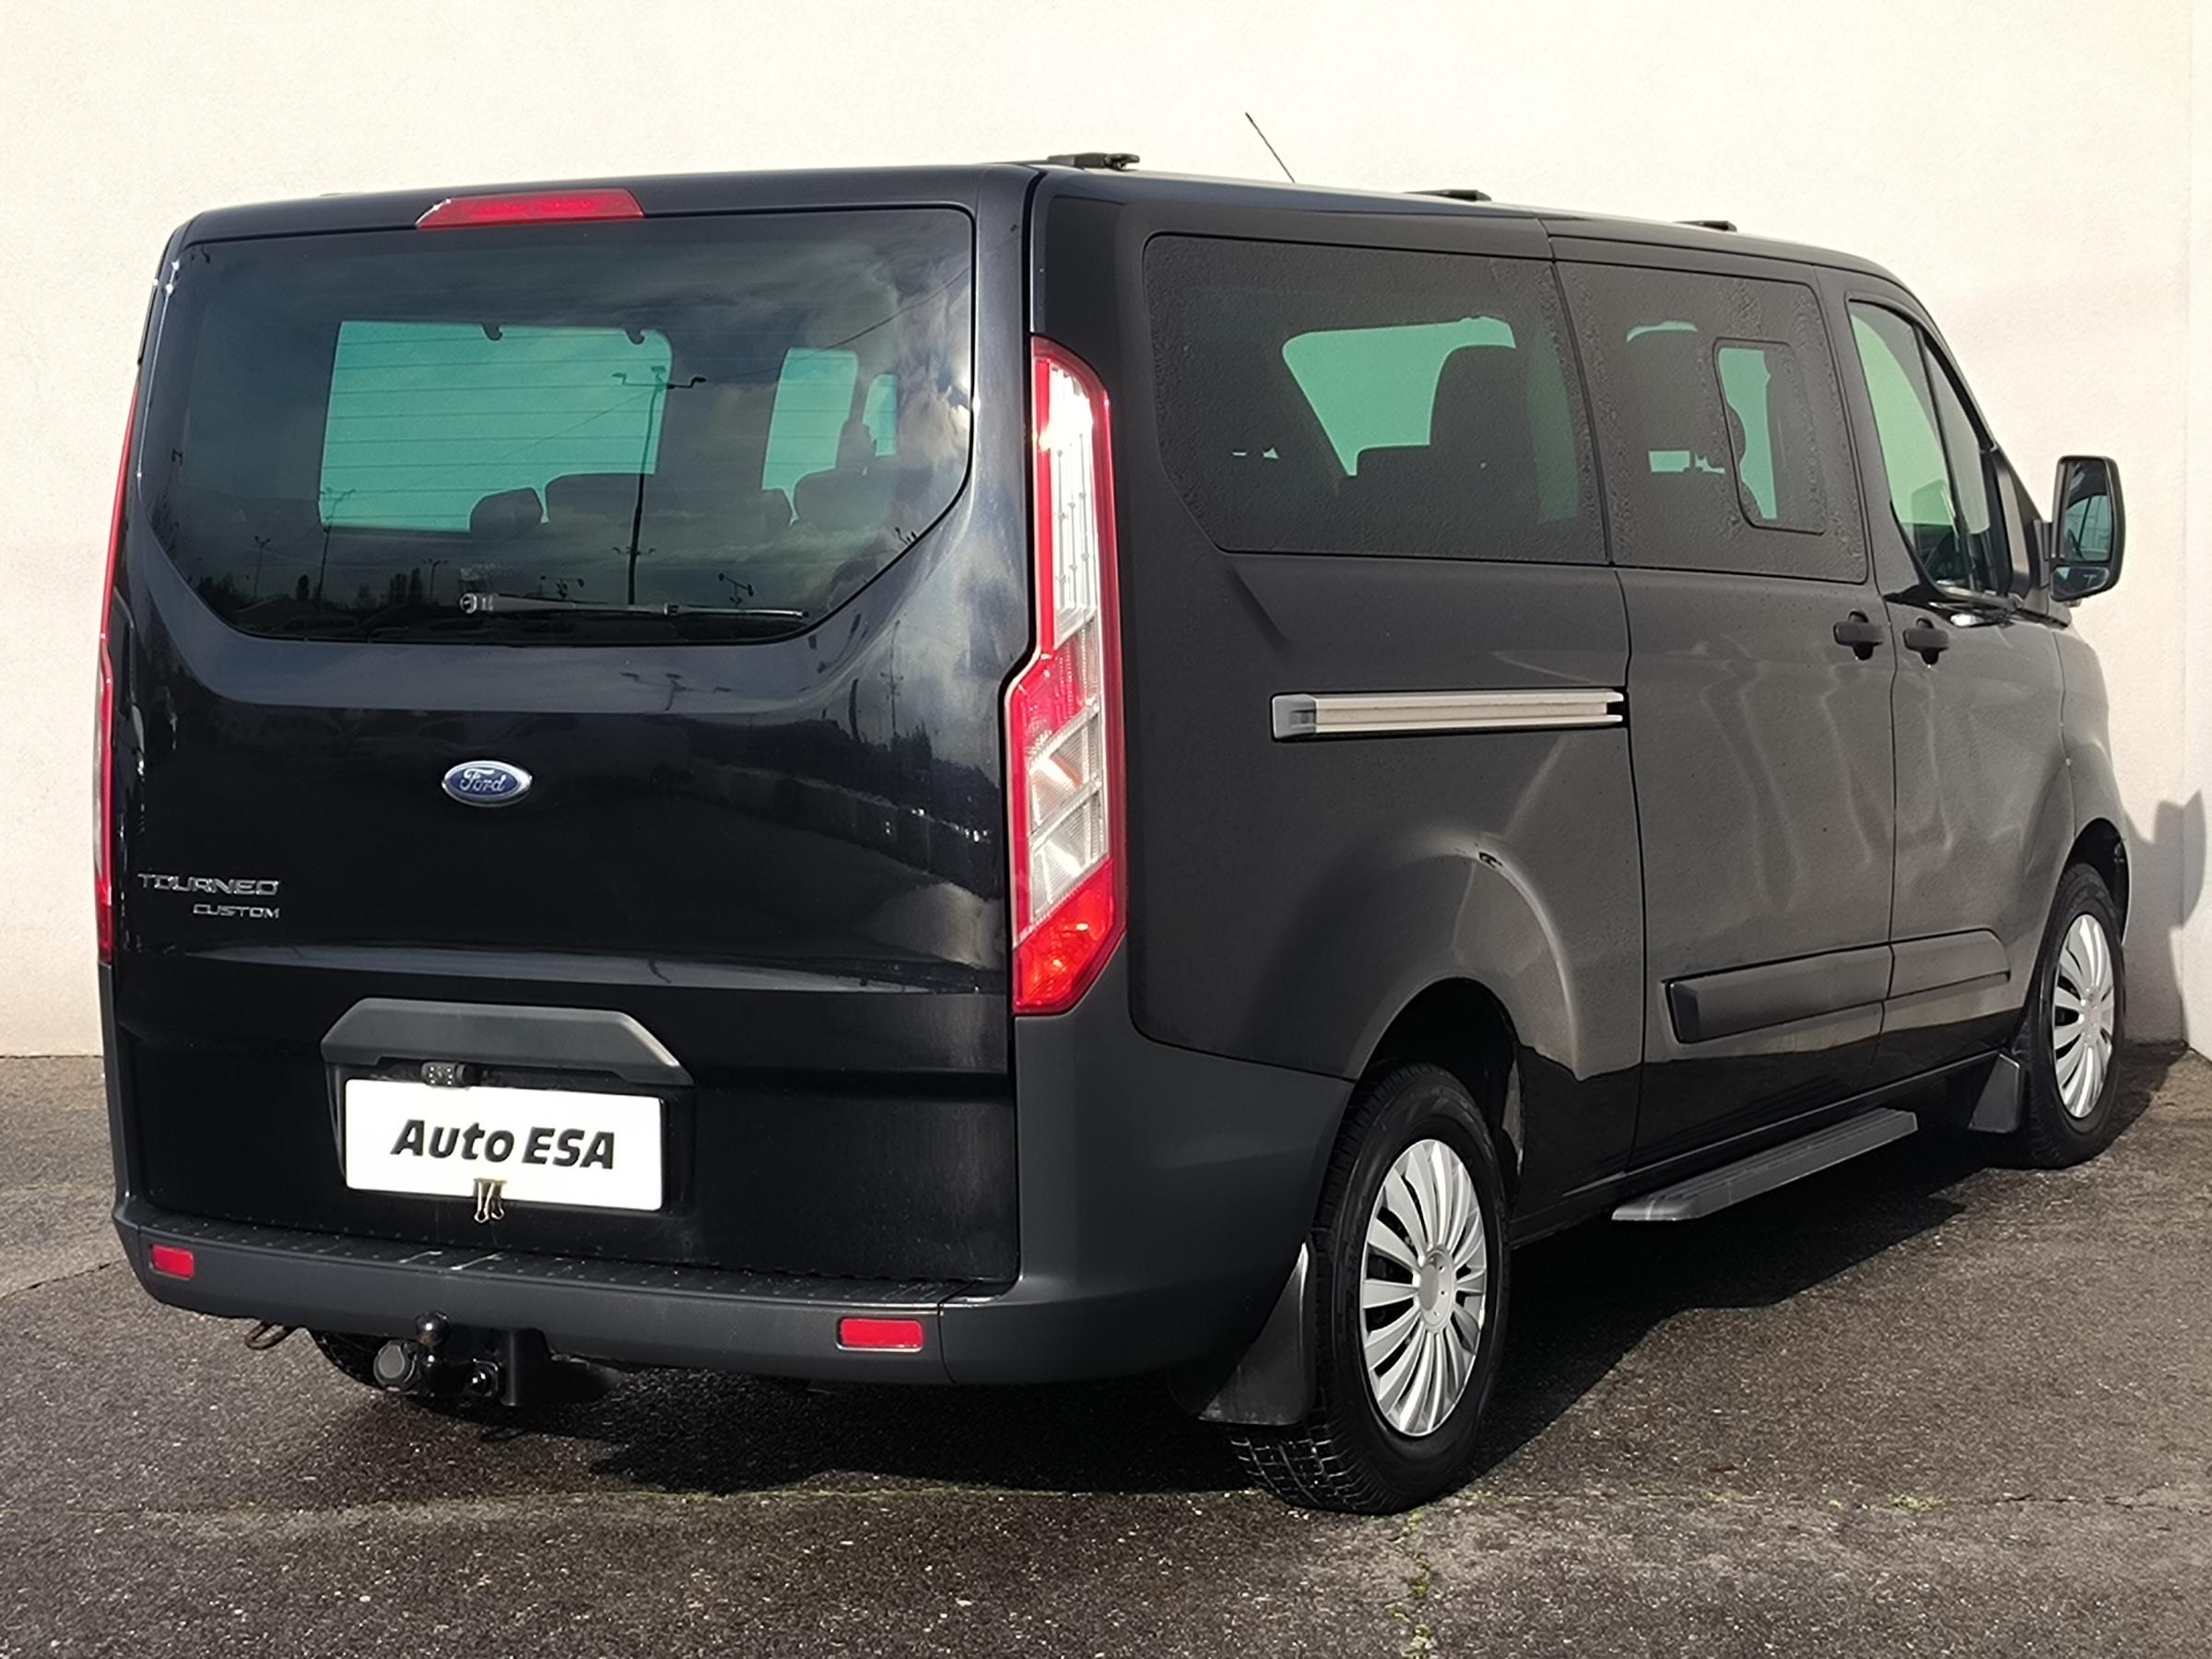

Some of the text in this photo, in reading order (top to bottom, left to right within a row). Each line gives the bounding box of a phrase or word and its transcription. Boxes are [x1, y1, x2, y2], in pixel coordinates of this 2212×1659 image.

[460, 768, 506, 792] Ford
[137, 873, 279, 896] TOURNEO
[193, 903, 280, 919] CUSTOM
[390, 1119, 615, 1170] Auto ESA
